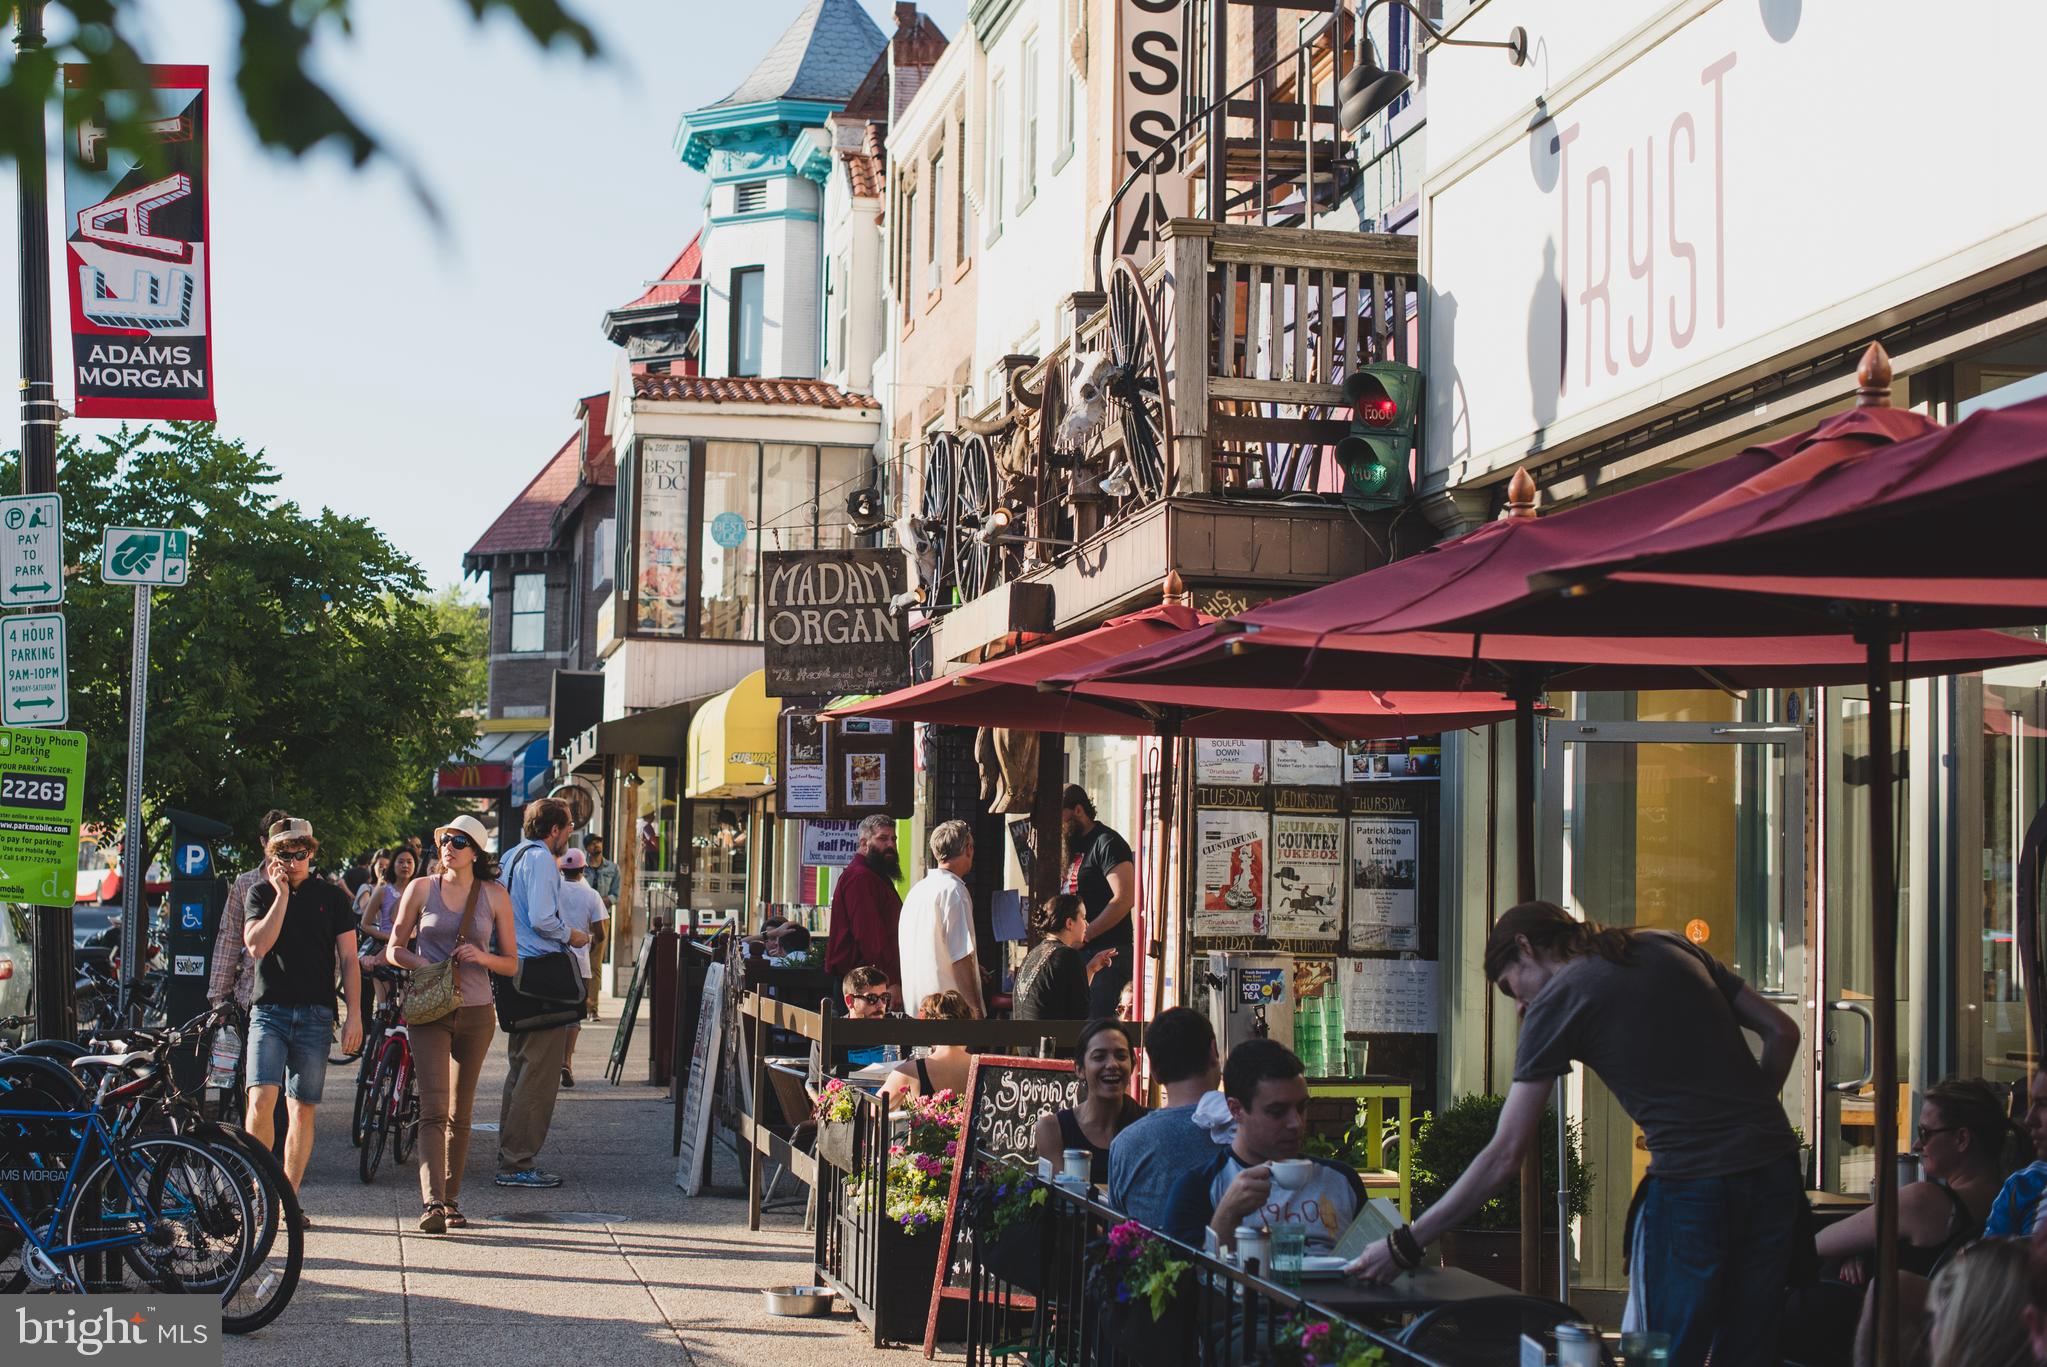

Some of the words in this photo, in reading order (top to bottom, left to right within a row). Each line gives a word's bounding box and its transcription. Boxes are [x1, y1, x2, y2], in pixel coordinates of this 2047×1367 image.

[1548, 50, 1738, 399] TRYST
[88, 344, 191, 366] ADAMS
[79, 366, 205, 389] MORGAN
[645, 459, 688, 474] BEST
[18, 534, 40, 545] PAY
[168, 532, 177, 552] 4
[23, 550, 37, 560] TO
[15, 566, 44, 576] PARK
[9, 630, 17, 642] 4
[22, 628, 54, 642] HOUR
[11, 646, 55, 662] PARKING
[8, 667, 59, 680] 9AM-10PM
[11, 683, 57, 692] MONDAY-SATURDAY
[15, 733, 33, 745] Pay
[35, 734, 46, 746] by
[49, 735, 79, 747] Phone
[1211, 740, 1247, 748] SOULFUL
[14, 745, 51, 759] Parking
[1215, 748, 1241, 757] DOWN
[18, 764, 48, 773] PARKING
[2, 779, 65, 802] 22263
[1198, 786, 1262, 806] TUESDAY
[1274, 789, 1337, 810] WEDNESDAY
[1352, 796, 1407, 811] THURSDAY
[1278, 821, 1340, 833] HUMAN
[1356, 826, 1386, 835] Patrick
[1387, 827, 1412, 835] Alban
[7, 836, 20, 844] pay
[22, 836, 32, 844] for
[34, 838, 64, 848] parking:
[817, 840, 839, 851] Half
[1202, 830, 1258, 856] CLUSTERFUNK
[1277, 833, 1339, 850] COUNTRY
[1366, 837, 1373, 845] &
[186, 845, 205, 873] P
[1277, 849, 1338, 864] JUKEBOX
[1371, 848, 1397, 856] Latina
[1205, 935, 1257, 951] FRIDAY
[1272, 937, 1335, 954] SATURDAY
[1243, 983, 1261, 992] ICED
[1243, 992, 1260, 1000] TEA
[995, 1070, 1081, 1118] Spring
[0, 1170, 20, 1181] MS
